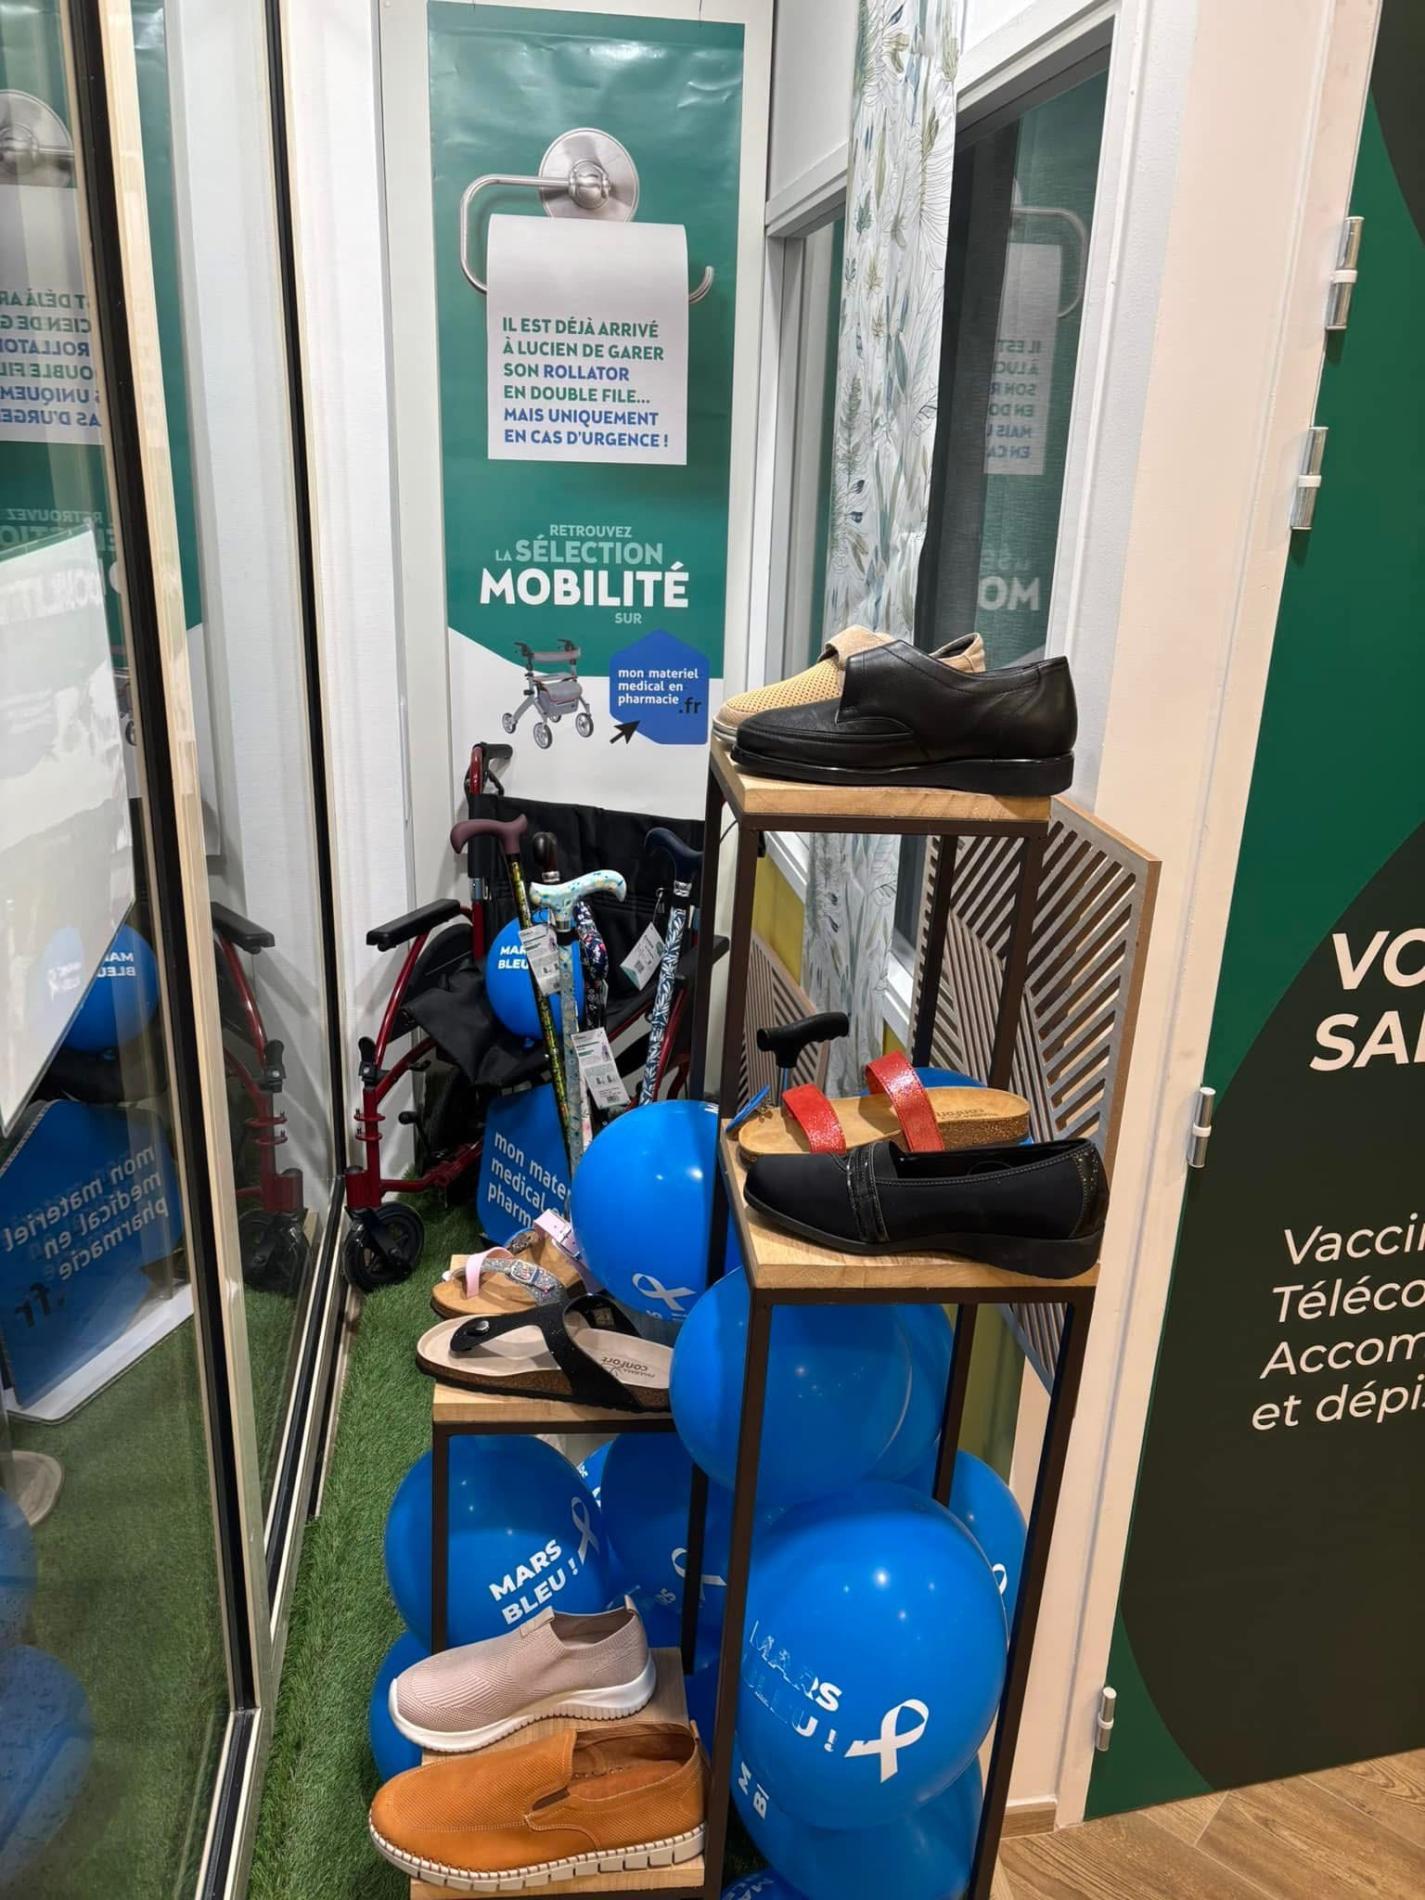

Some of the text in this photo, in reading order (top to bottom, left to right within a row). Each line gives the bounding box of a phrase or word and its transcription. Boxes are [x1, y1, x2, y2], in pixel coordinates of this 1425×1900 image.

[502, 316, 659, 338] IL EST DÉJÀ ARRIVÉ
[502, 336, 664, 361] À LUCIEN DE GARER
[503, 362, 630, 381] SON ROLLATOR
[504, 385, 650, 404] EN DOUBLE FILE...
[504, 407, 659, 427] MAIS UNIQUEMENT
[504, 429, 526, 443] EN
[531, 430, 563, 444] CAS
[566, 431, 660, 448] D'URGENCE
[549, 524, 632, 538] RETROUVEZ
[495, 534, 663, 565] LA SÉLECTION
[480, 561, 689, 608] MOBILITÉ
[615, 612, 642, 625] SUR
[618, 667, 699, 680] mon materiel
[618, 680, 684, 692] medical en
[618, 694, 702, 715] pharmacie .fr
[500, 945, 528, 956] MAR
[494, 1132, 525, 1168] mon
[491, 1157, 545, 1213] medical
[1272, 1274, 1425, 1324] Téléco
[600, 1356, 649, 1372] confort
[1251, 1373, 1425, 1431] et dépi
[488, 1538, 562, 1602] MARS
[501, 1567, 566, 1625] BLEU
